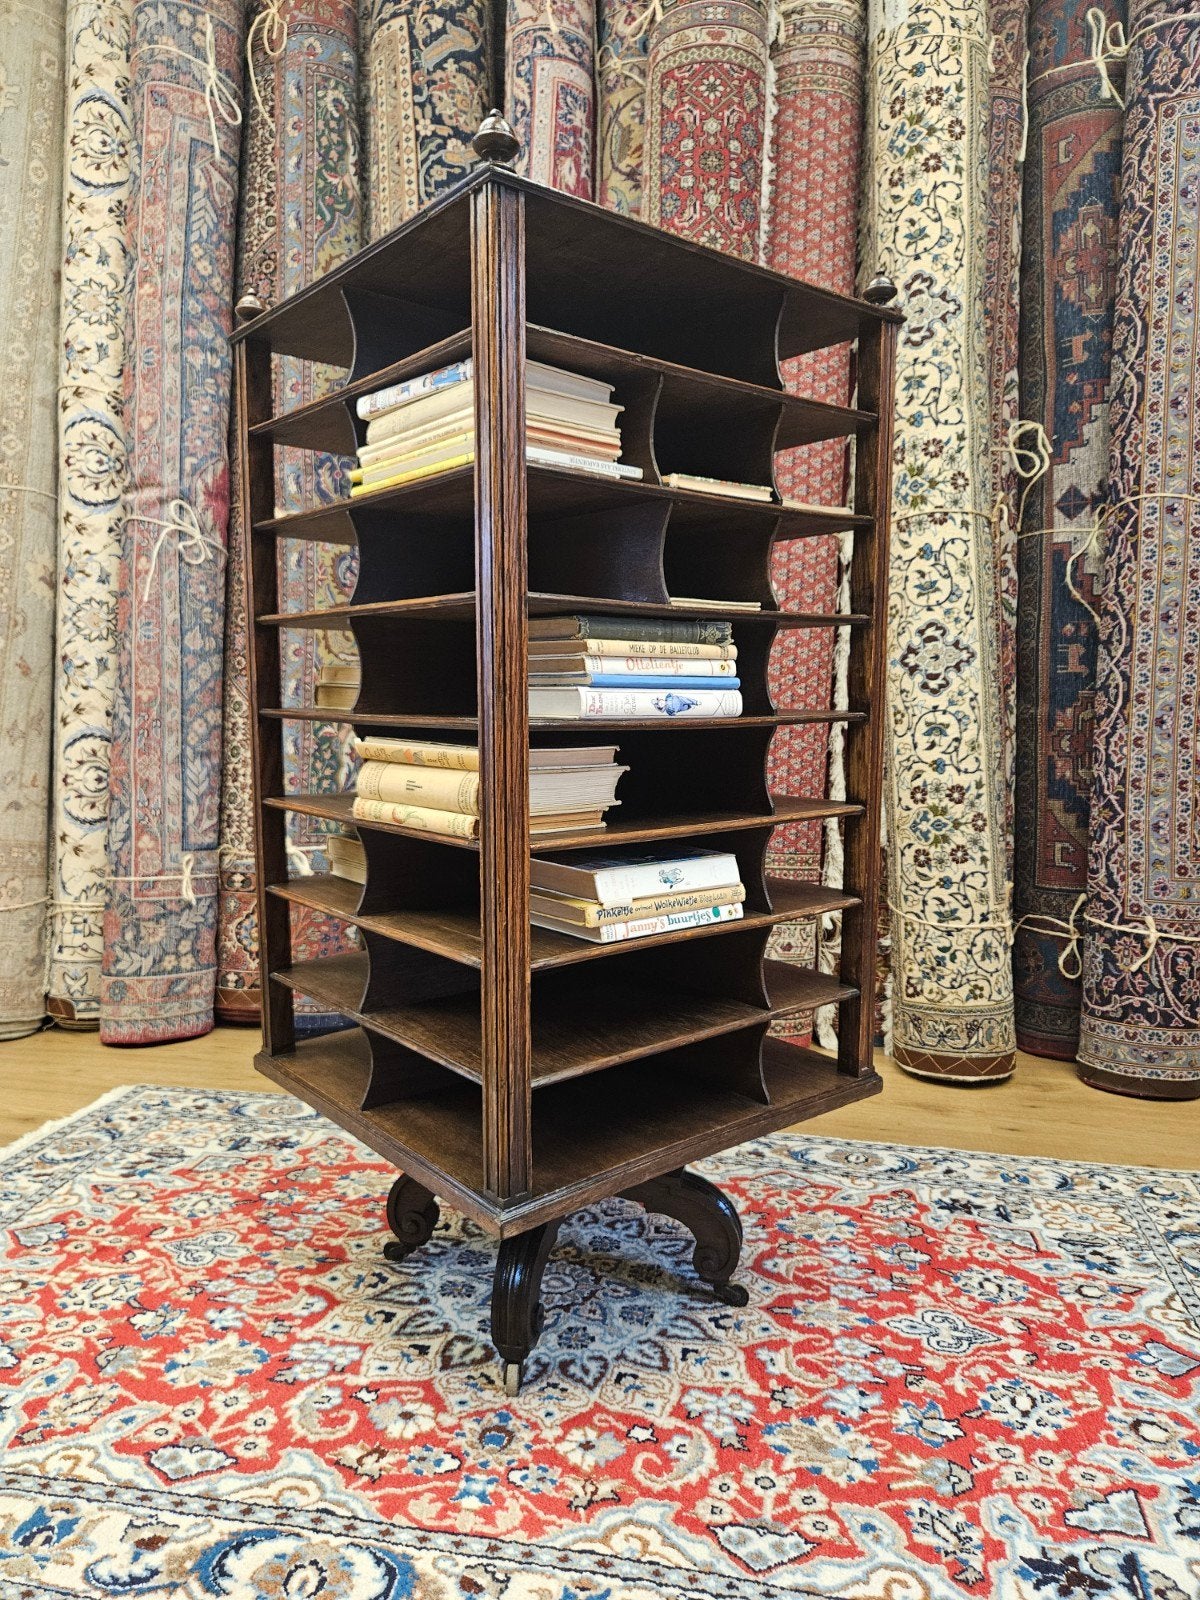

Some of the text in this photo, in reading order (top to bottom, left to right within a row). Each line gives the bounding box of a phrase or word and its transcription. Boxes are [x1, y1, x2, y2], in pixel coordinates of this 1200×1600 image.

[629, 644, 700, 655] MIEKE OP DE BALLETCLUB
[625, 657, 684, 673] Ottelientje
[622, 917, 666, 938] Janny's
[667, 911, 711, 926] buurtjes
